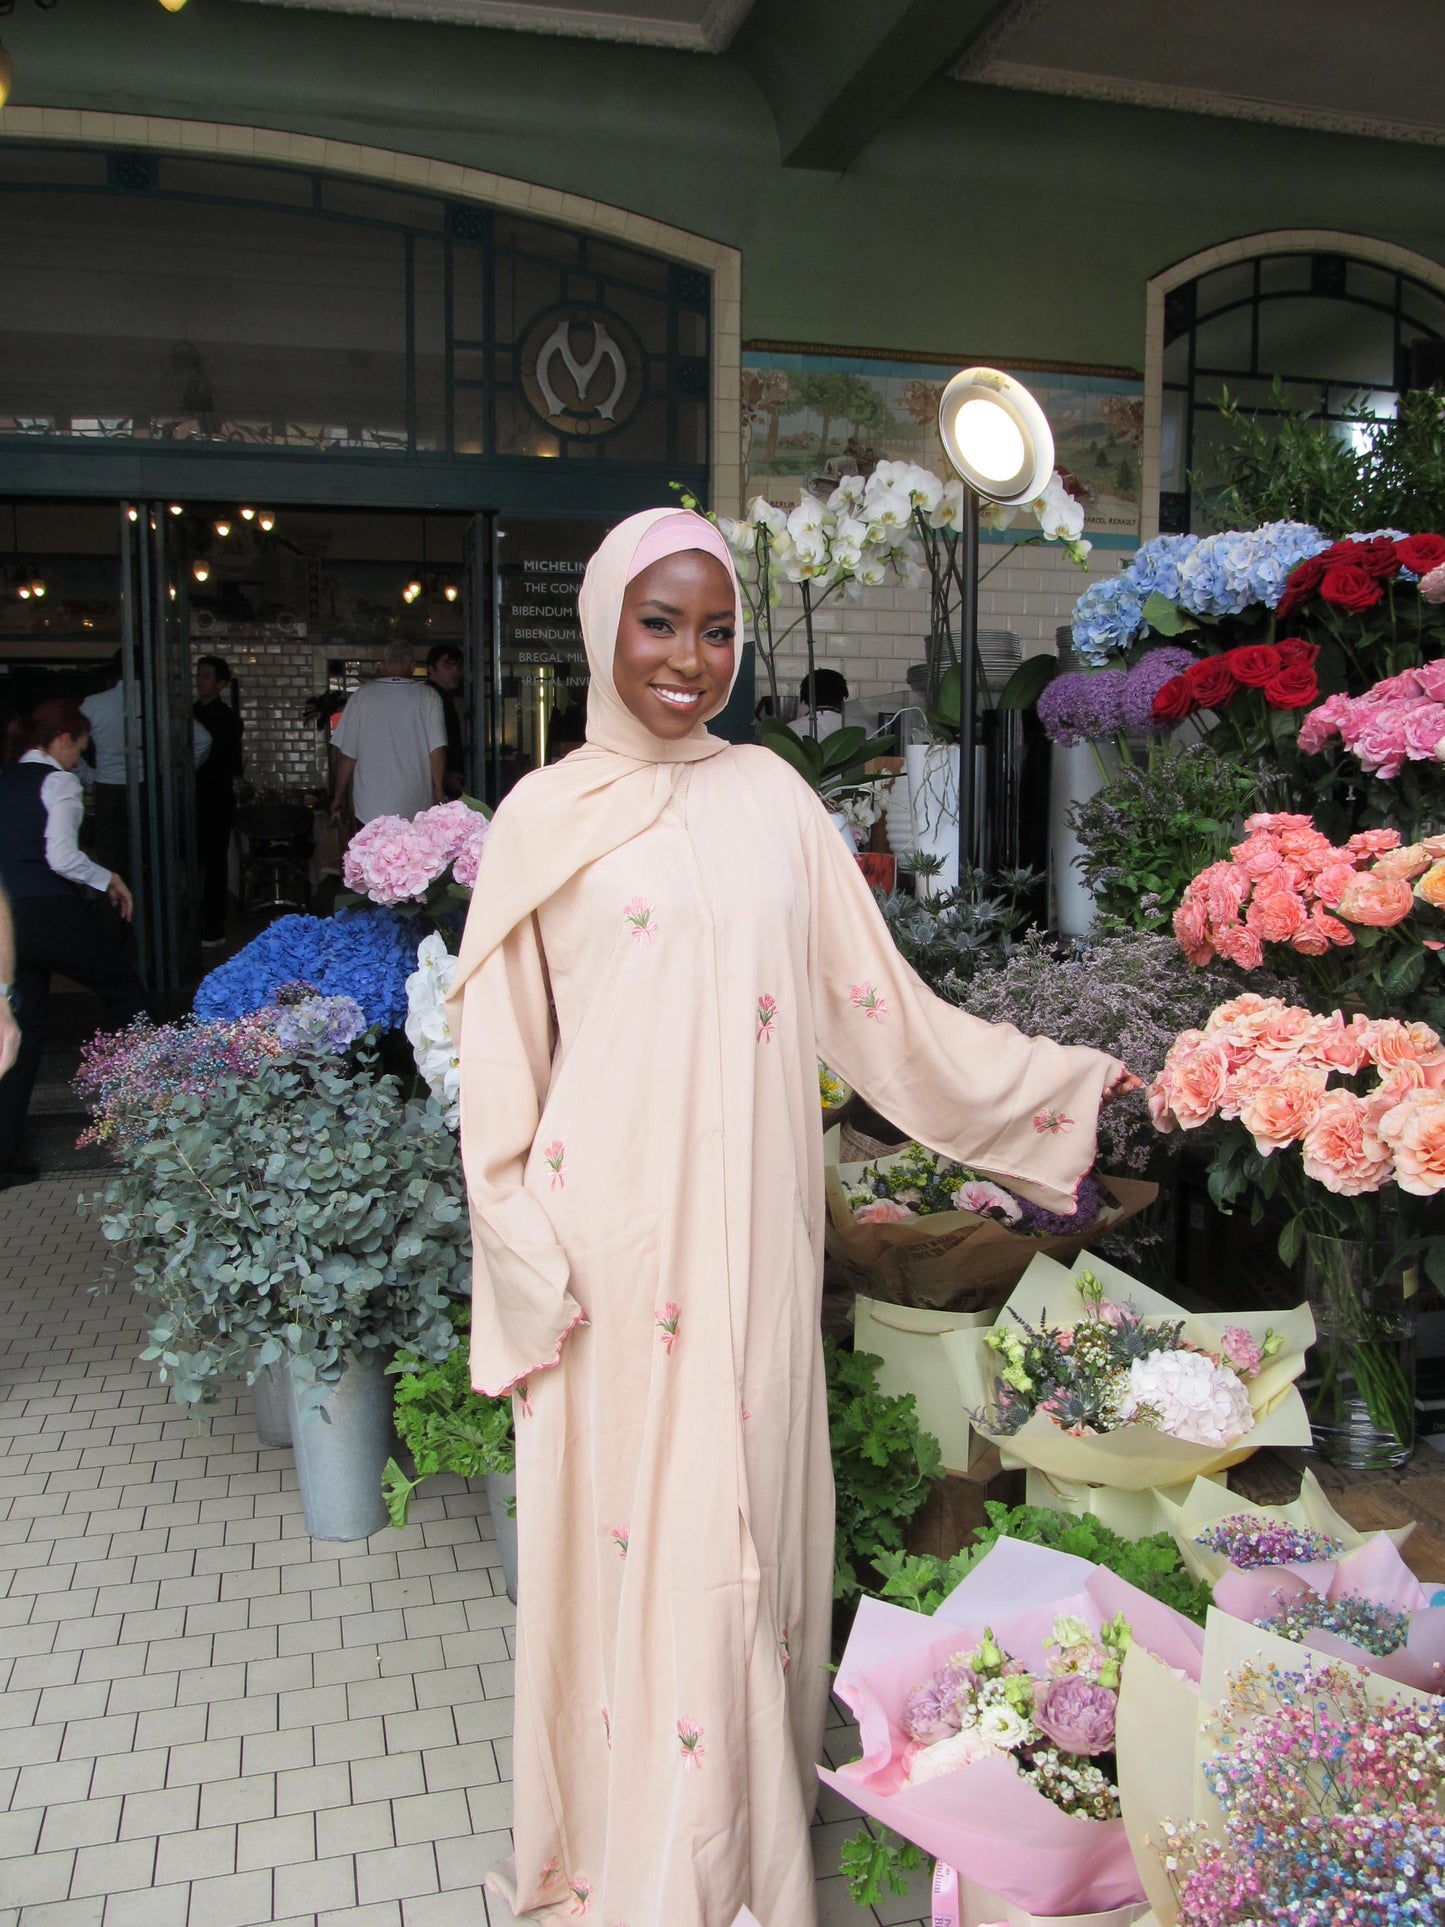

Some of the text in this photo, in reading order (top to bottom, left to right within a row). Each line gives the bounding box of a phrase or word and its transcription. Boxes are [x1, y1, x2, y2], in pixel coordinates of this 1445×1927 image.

[523, 560, 587, 572] MICHELIN
[523, 582, 582, 594] THE CON
[512, 605, 573, 617] BIBENDUM
[515, 628, 576, 639] BIBENDUM
[518, 652, 564, 663] BREGAL
